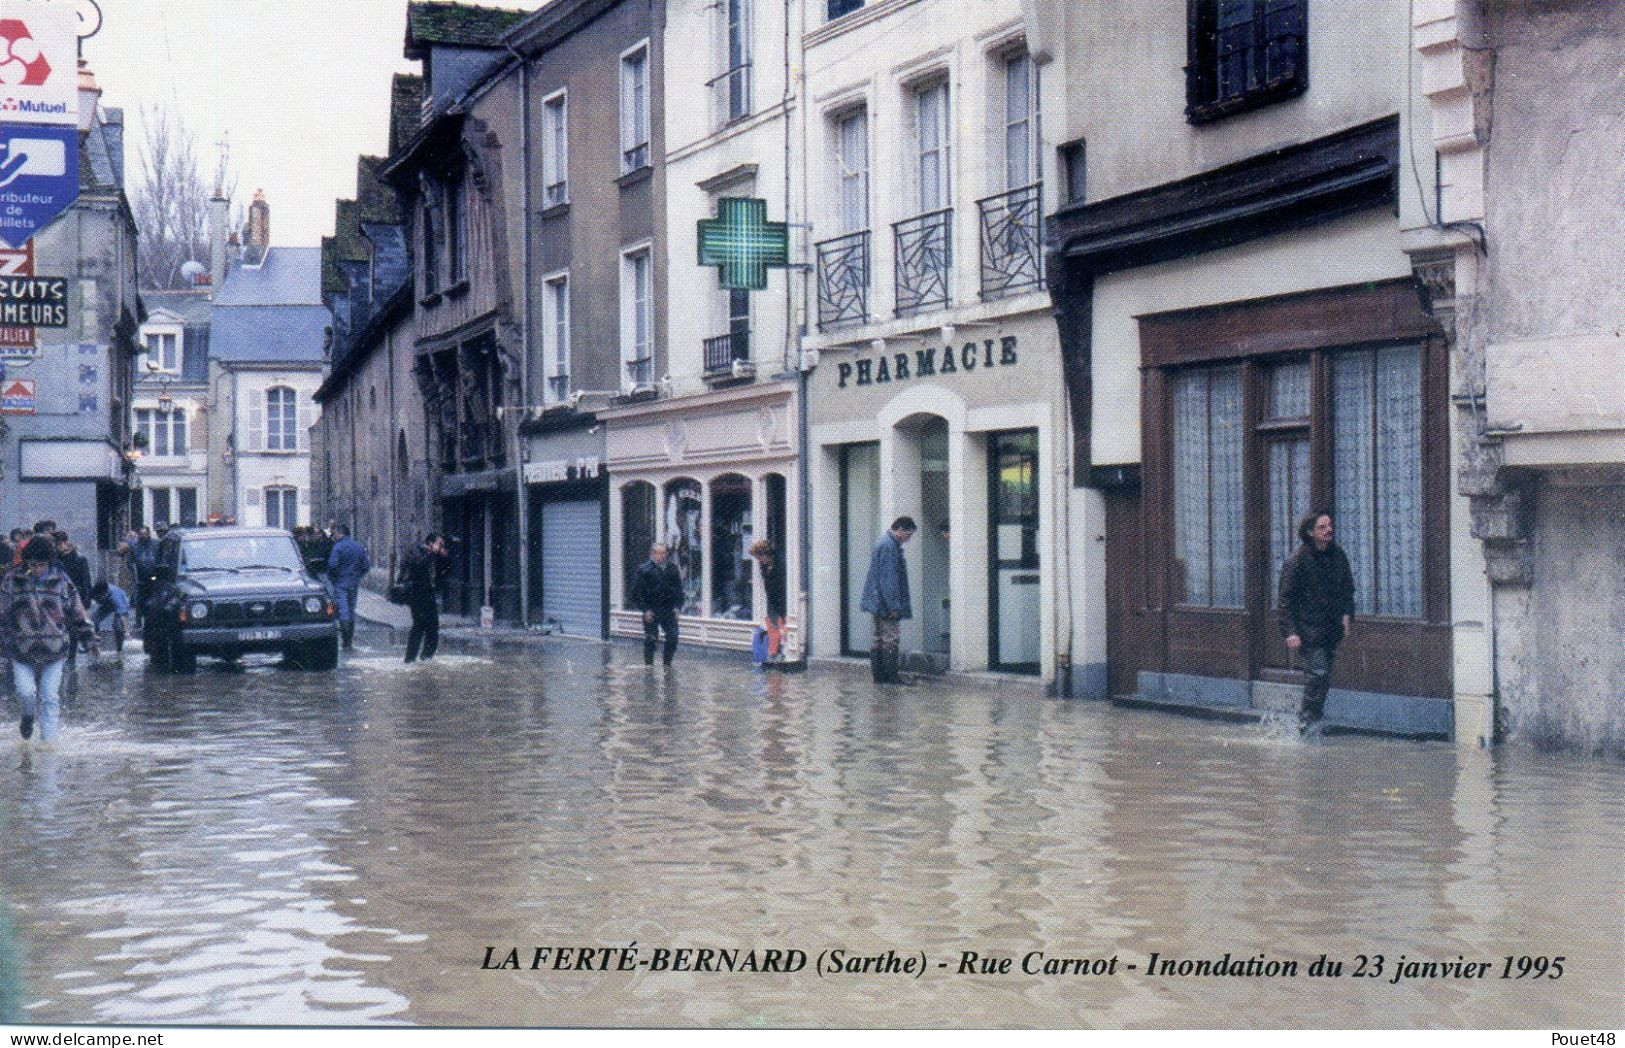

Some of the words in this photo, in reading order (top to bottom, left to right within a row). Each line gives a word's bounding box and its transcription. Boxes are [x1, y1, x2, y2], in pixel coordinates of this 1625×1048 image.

[19, 99, 66, 113] Mutuel
[6, 204, 23, 215] de
[837, 335, 1018, 389] PHARMACIE
